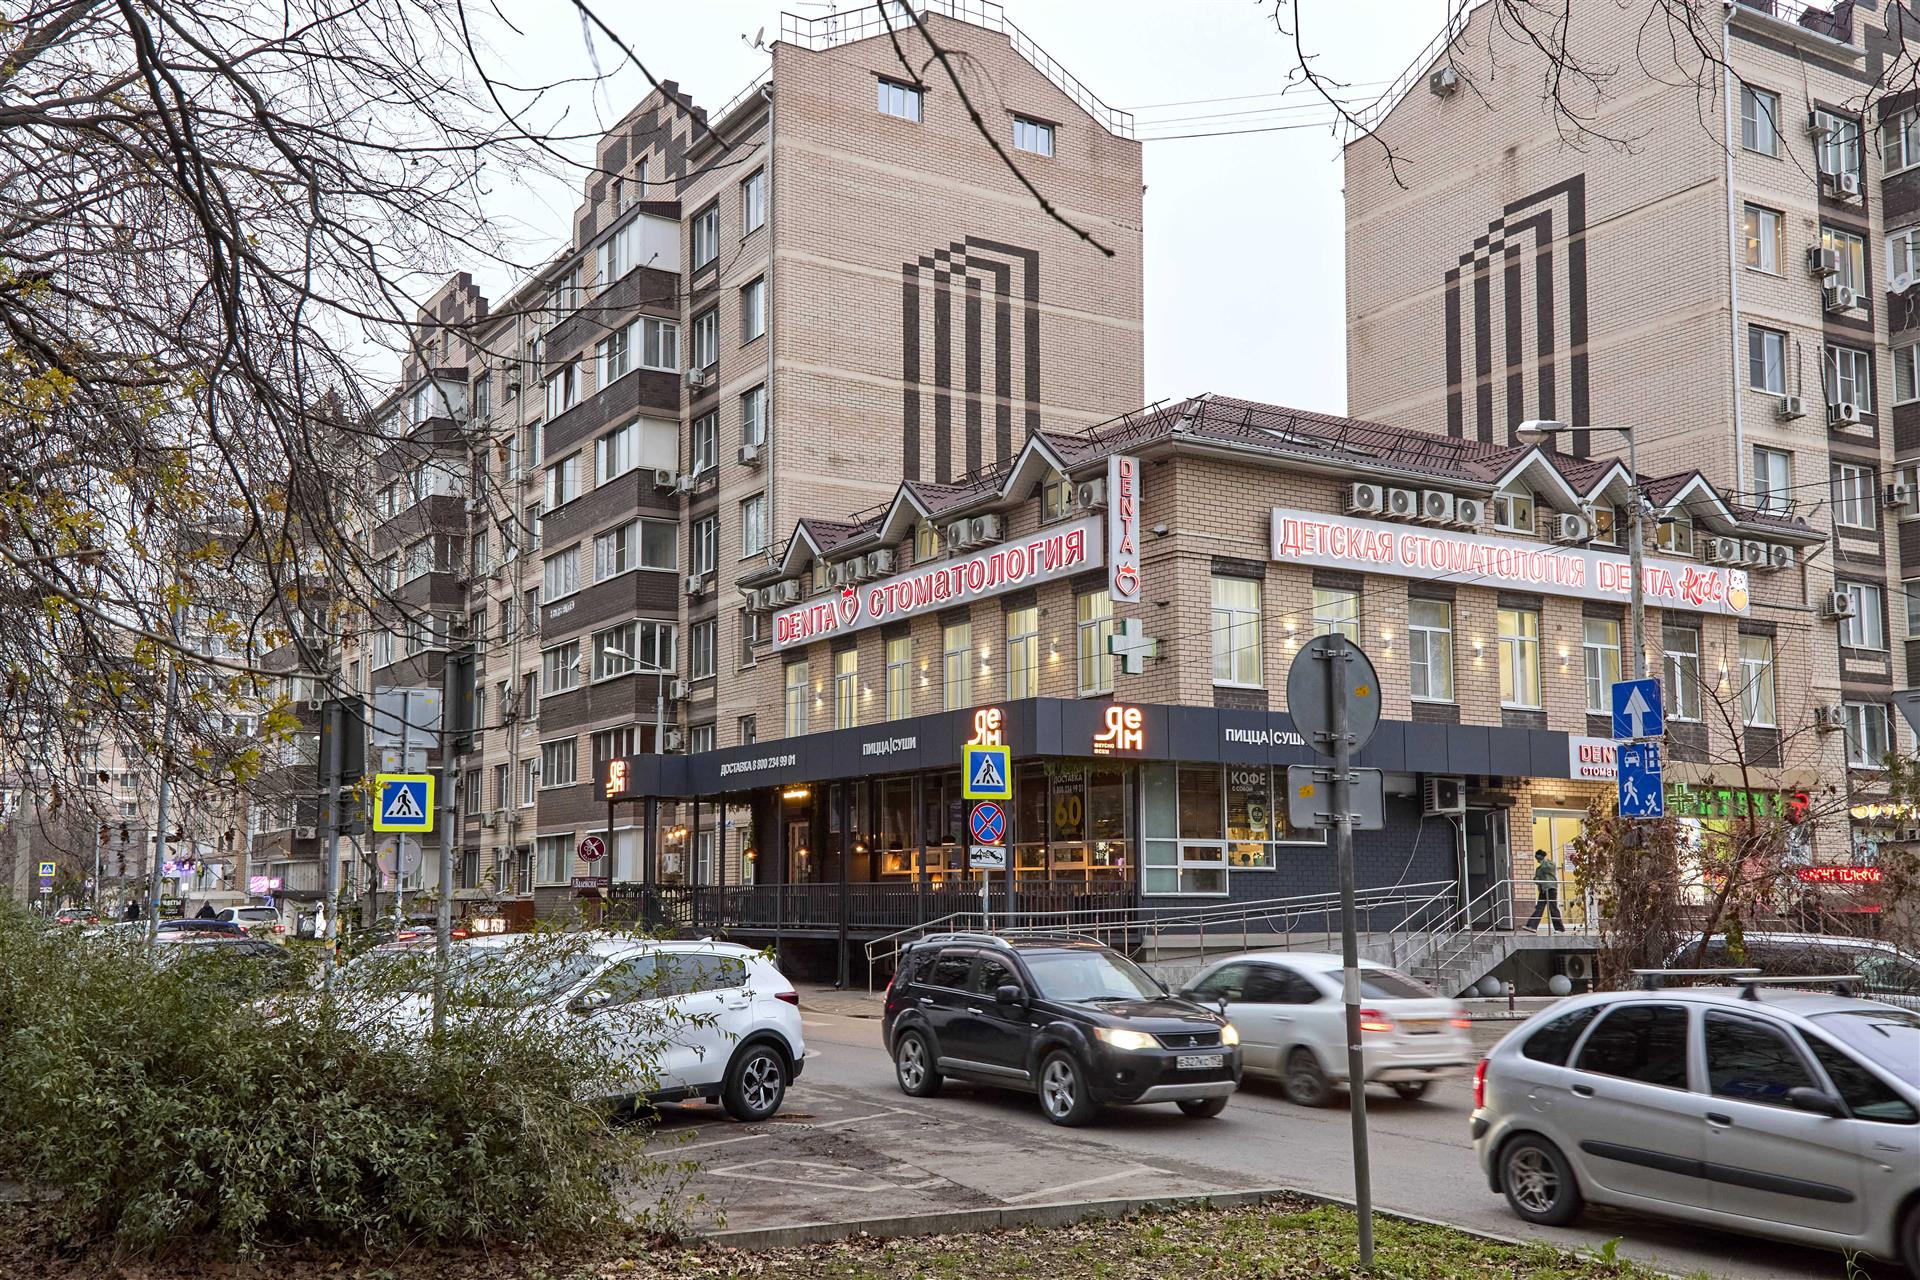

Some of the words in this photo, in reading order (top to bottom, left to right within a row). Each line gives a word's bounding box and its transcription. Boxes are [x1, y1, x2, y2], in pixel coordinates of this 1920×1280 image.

[1119, 458, 1135, 553] DENTA
[1280, 518, 1394, 562] ДЕТСКАЯ
[1400, 535, 1585, 587] СТОМАТОЛОГИЯ
[777, 602, 838, 642] DENTA
[720, 761, 752, 776] ДОСТАВКА
[757, 758, 768, 770] 800
[768, 756, 779, 768] 234
[1231, 771, 1266, 785] КОФЕ
